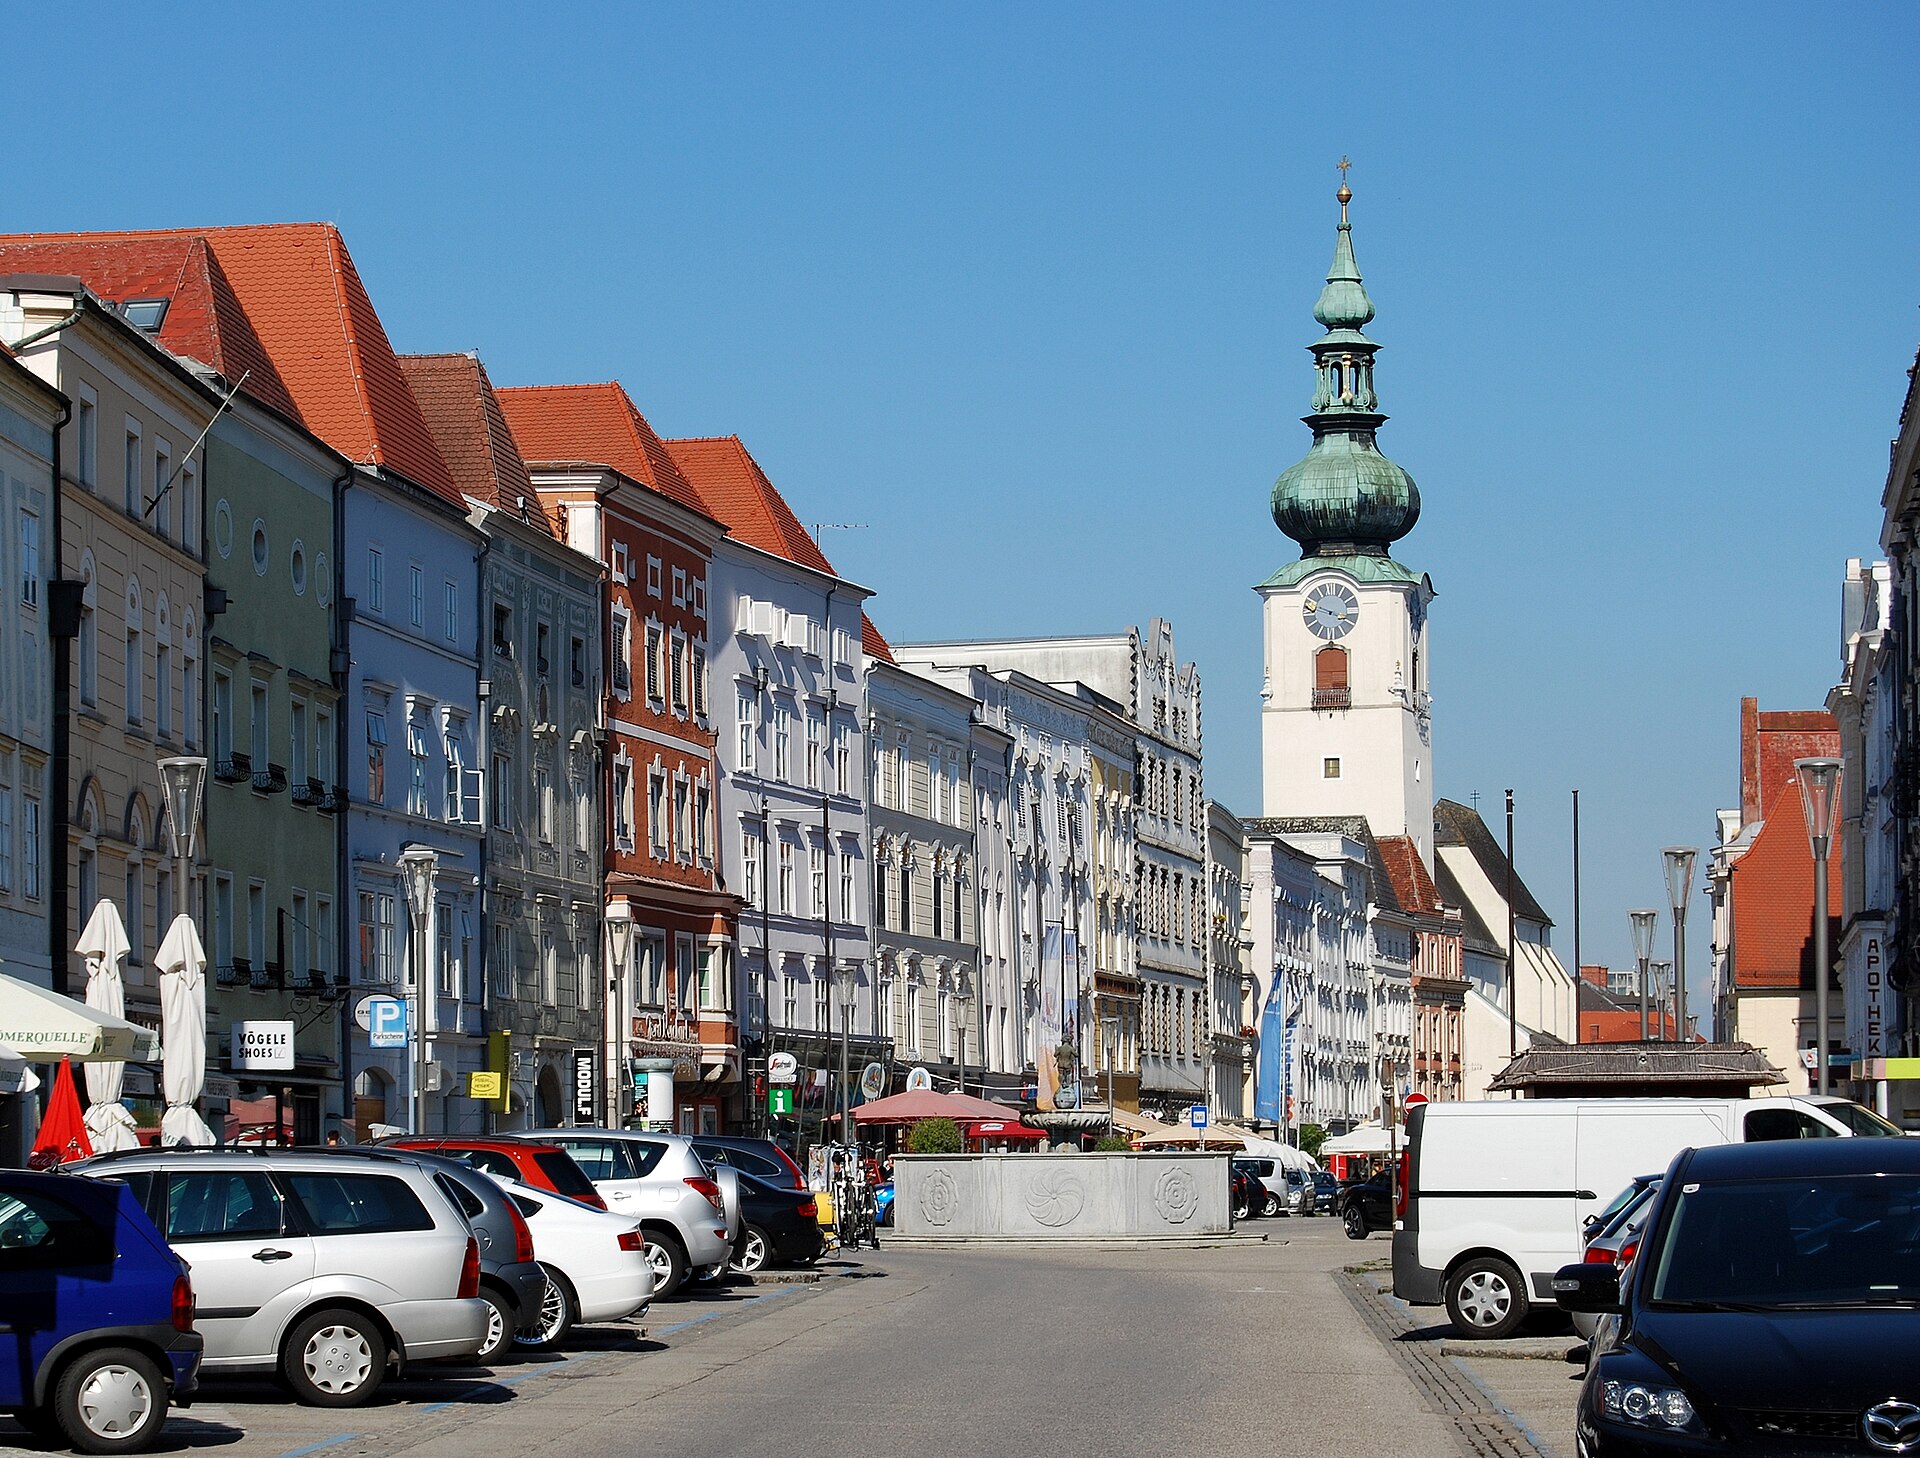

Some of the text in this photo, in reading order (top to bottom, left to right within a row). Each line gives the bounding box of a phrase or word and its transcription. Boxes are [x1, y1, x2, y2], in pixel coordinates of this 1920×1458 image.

[1867, 939, 1881, 1058] APOTHEK
[376, 1002, 400, 1034] P
[238, 1048, 272, 1058] SHOES
